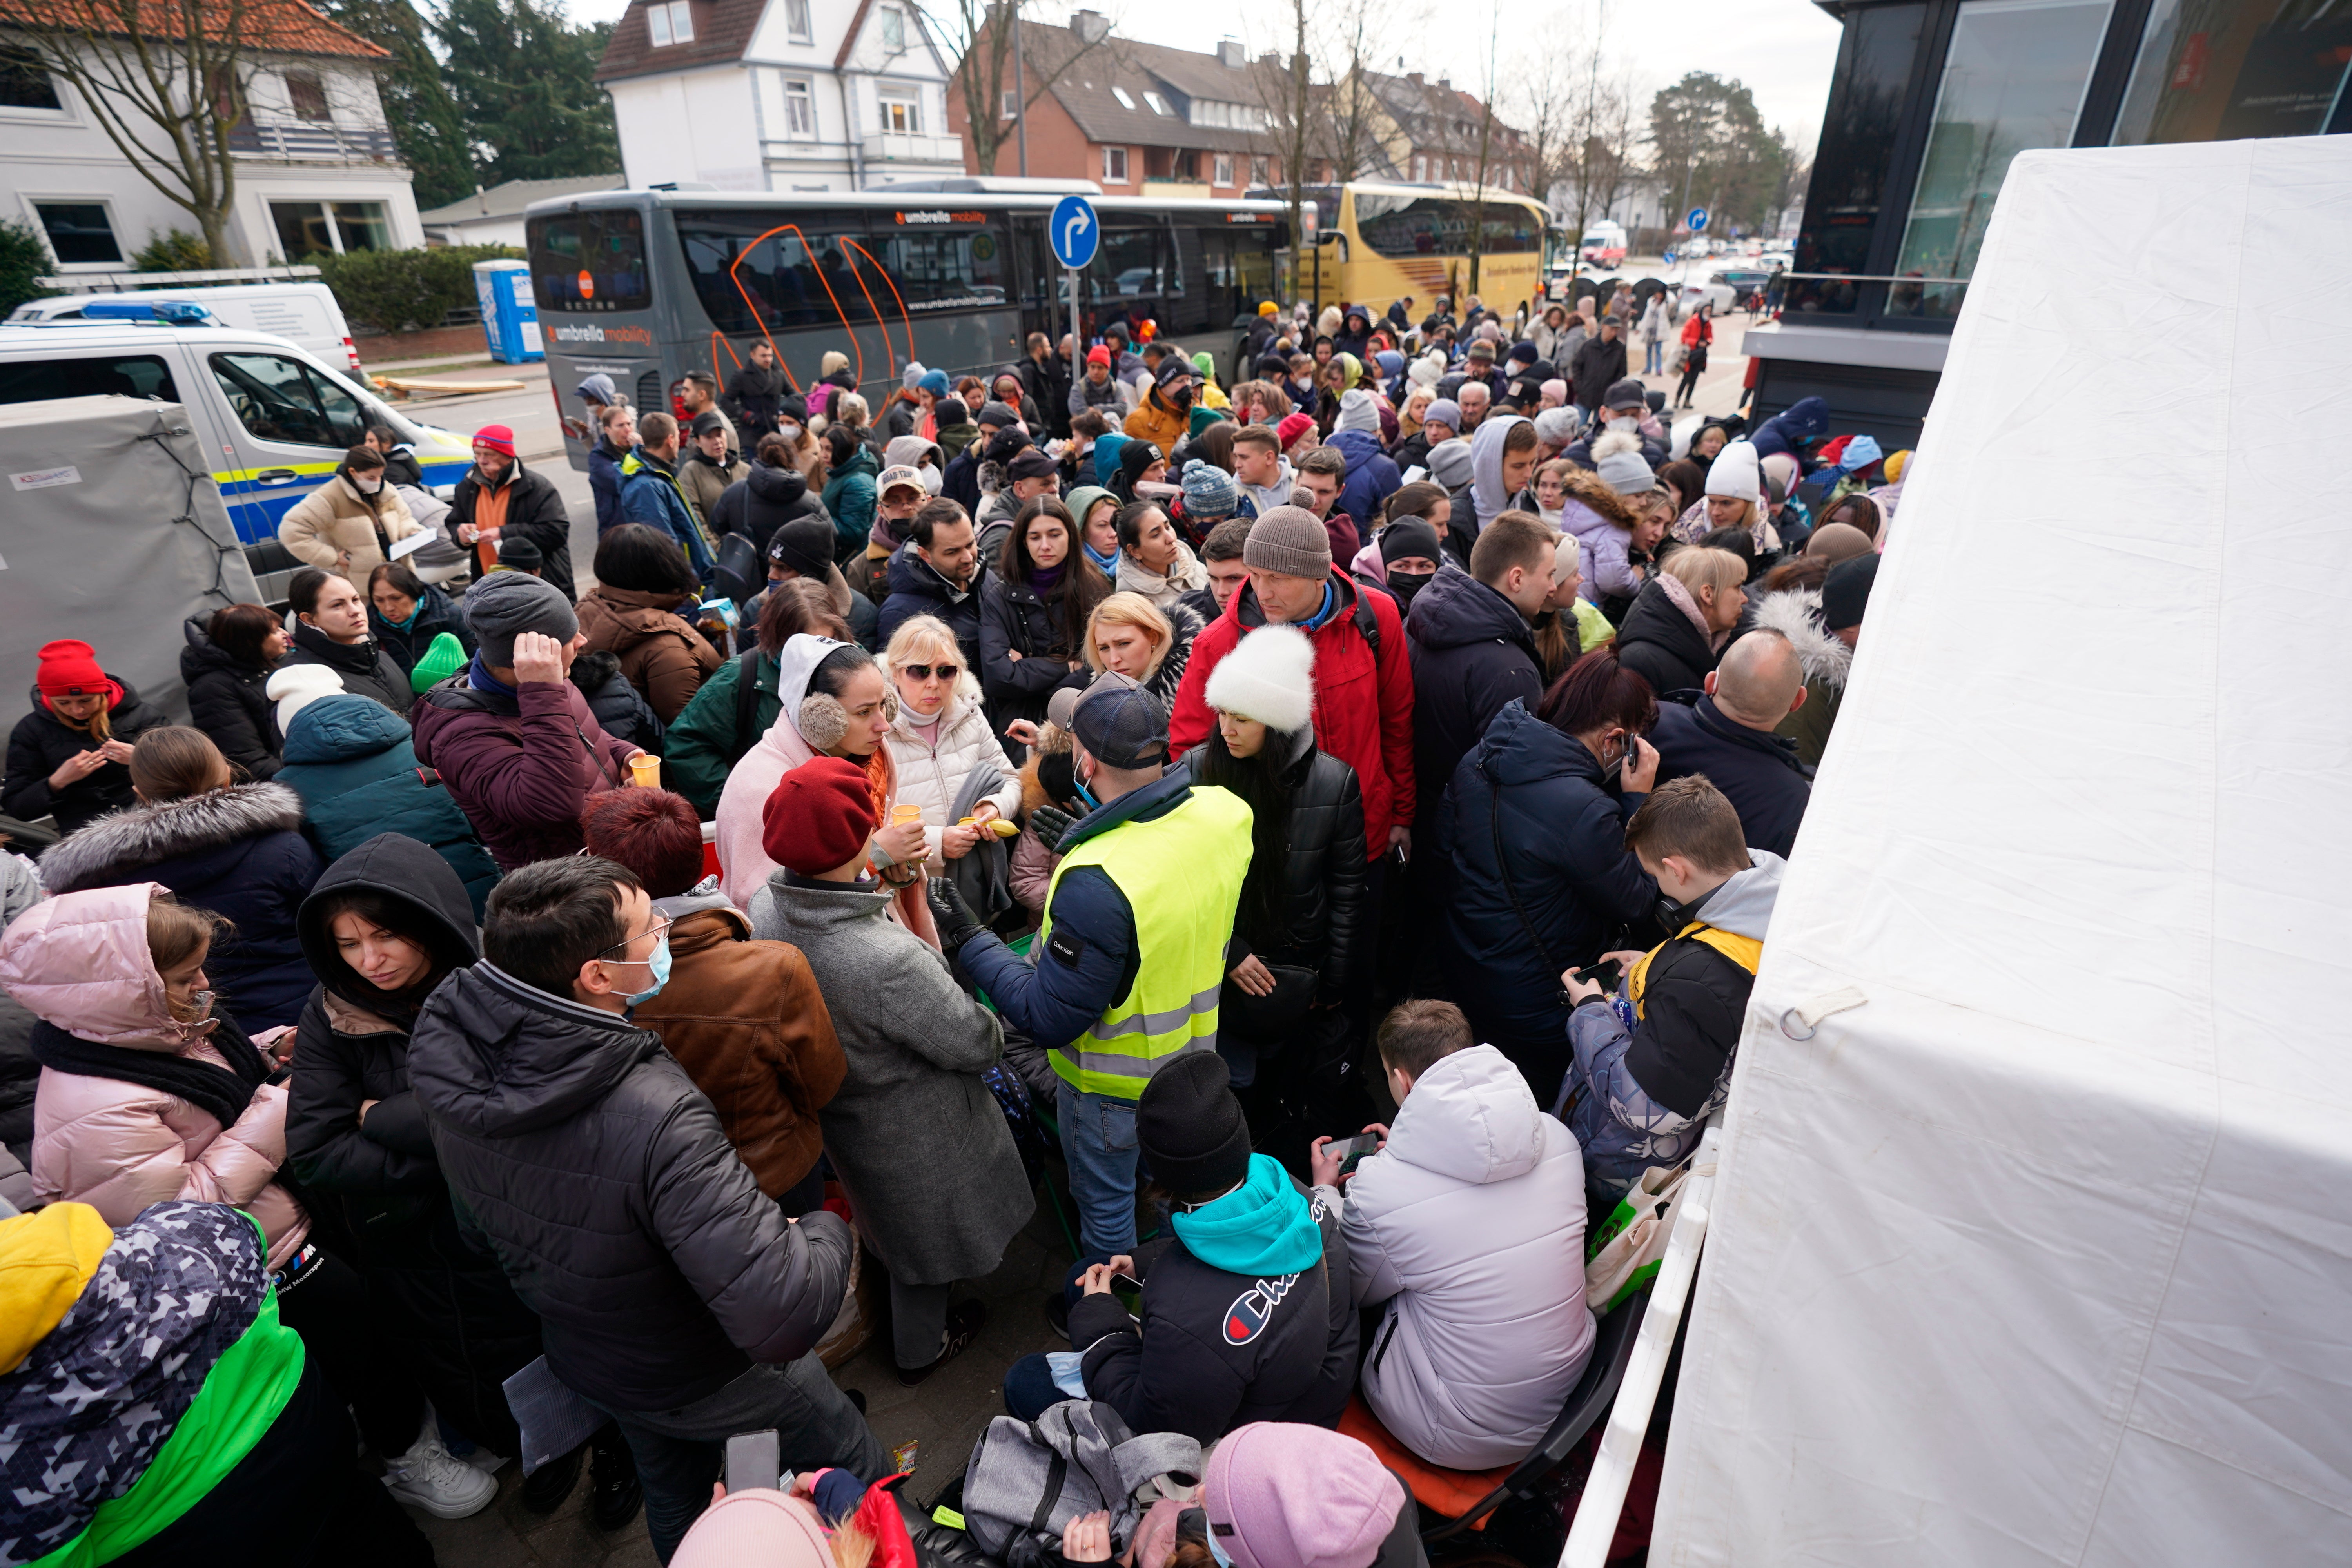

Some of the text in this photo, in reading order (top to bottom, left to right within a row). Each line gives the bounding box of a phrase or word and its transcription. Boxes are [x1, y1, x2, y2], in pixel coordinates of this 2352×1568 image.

[905, 210, 987, 225] umbrella mobility
[555, 323, 605, 342] umbrella
[604, 325, 651, 347] mobility
[1053, 940, 1074, 956] Calvin Klein
[292, 1257, 325, 1287] Motorsport
[901, 1463, 915, 1472] RIBO
